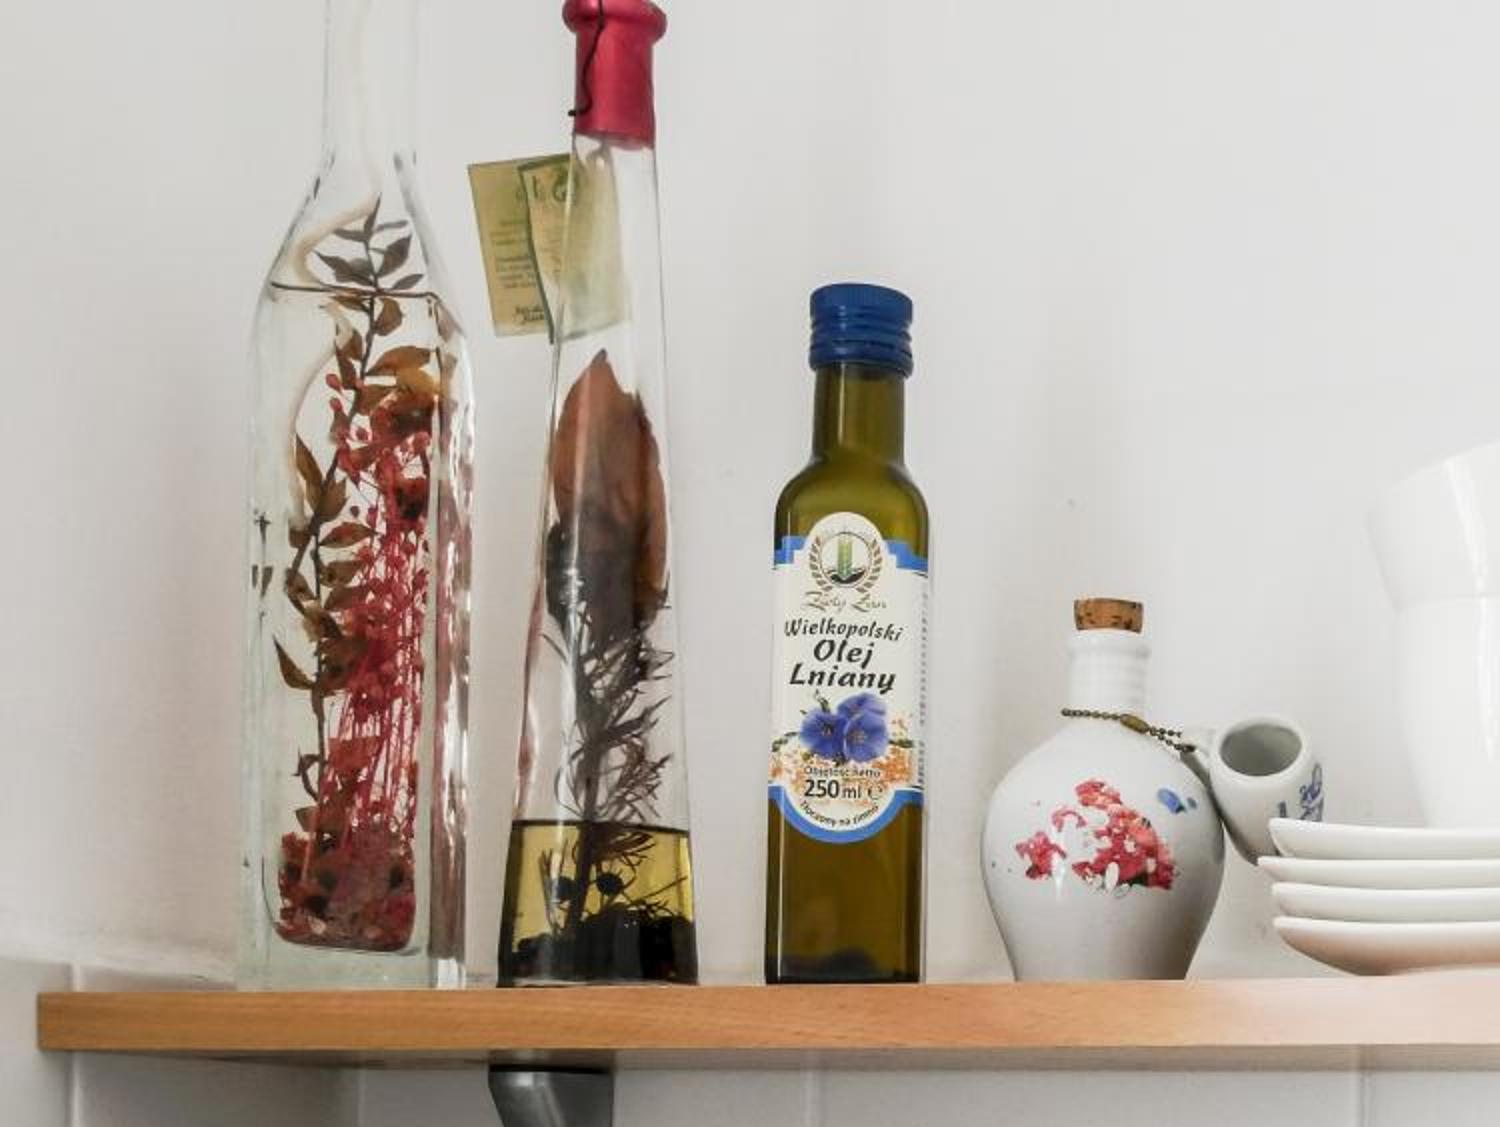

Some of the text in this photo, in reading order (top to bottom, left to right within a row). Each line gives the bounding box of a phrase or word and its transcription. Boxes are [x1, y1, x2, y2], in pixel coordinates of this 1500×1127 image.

[784, 617, 904, 641] Wielkopolski
[813, 639, 875, 670] Olej
[789, 662, 896, 695] Lniany
[804, 779, 862, 799] 250 ml
